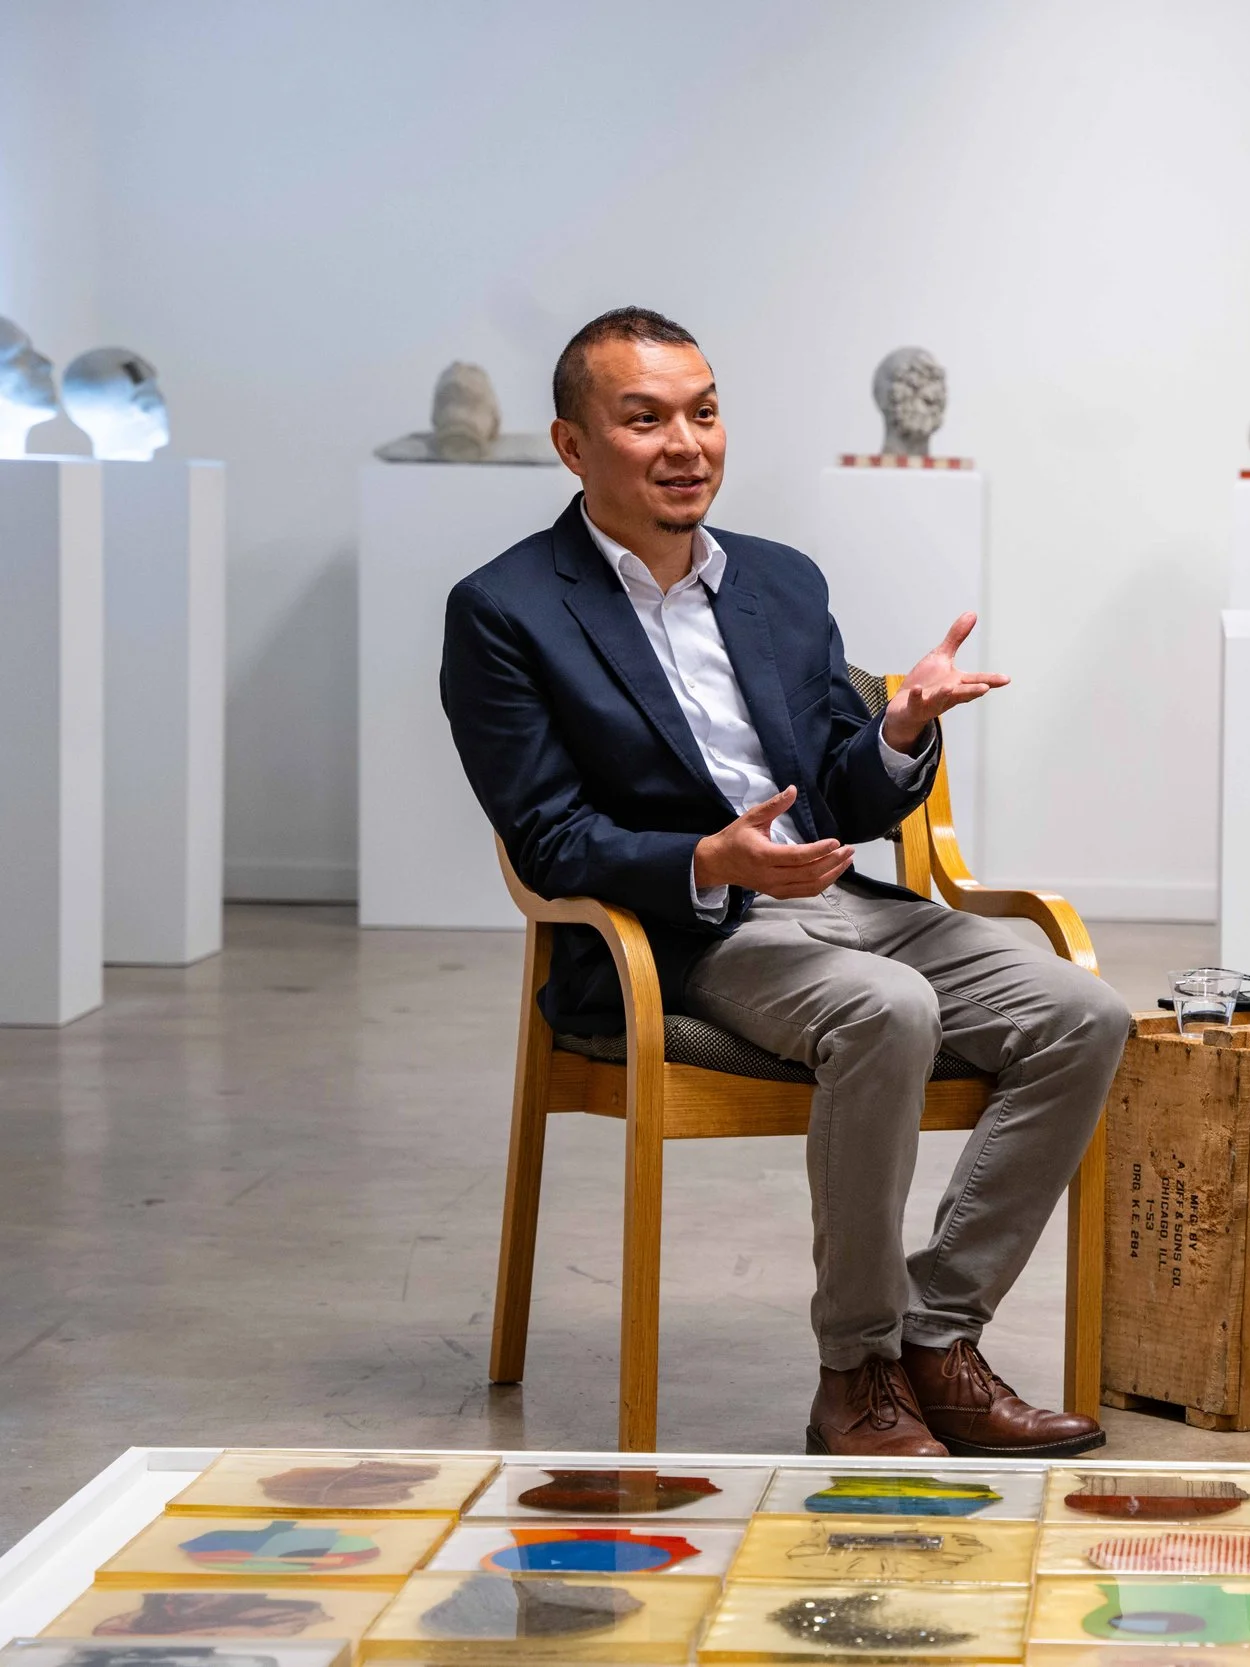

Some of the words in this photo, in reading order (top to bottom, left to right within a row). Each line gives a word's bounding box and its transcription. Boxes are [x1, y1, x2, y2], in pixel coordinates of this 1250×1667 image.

[1145, 1200, 1155, 1231] 1-53
[1159, 1177, 1170, 1241] CHICAGO,
[1175, 1211, 1184, 1219] &
[1130, 1230, 1140, 1258] 284
[1173, 1223, 1183, 1262] SONS
[1188, 1232, 1198, 1252] BY
